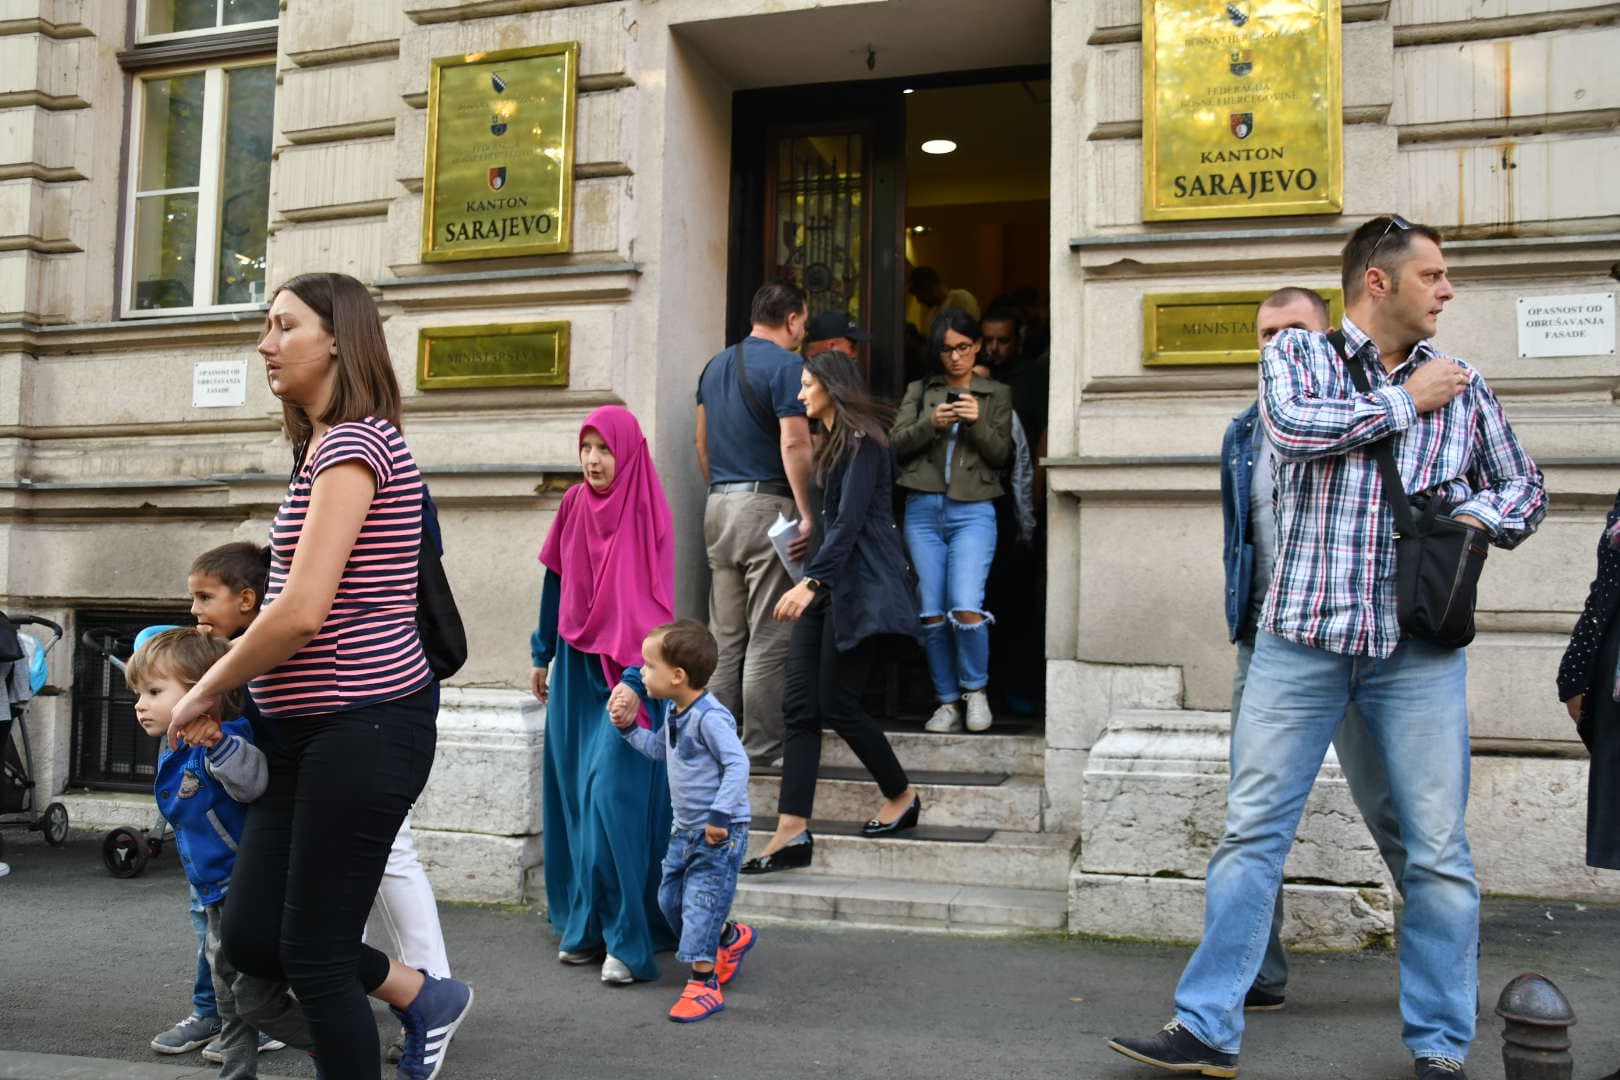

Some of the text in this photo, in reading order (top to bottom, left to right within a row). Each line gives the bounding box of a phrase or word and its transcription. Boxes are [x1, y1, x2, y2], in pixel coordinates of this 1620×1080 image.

[1200, 147, 1284, 164] KANTON
[1173, 168, 1318, 200] SARAJEVO
[466, 197, 528, 212] KANTON
[445, 214, 552, 243] SARAJEVO
[1586, 305, 1602, 313] OD
